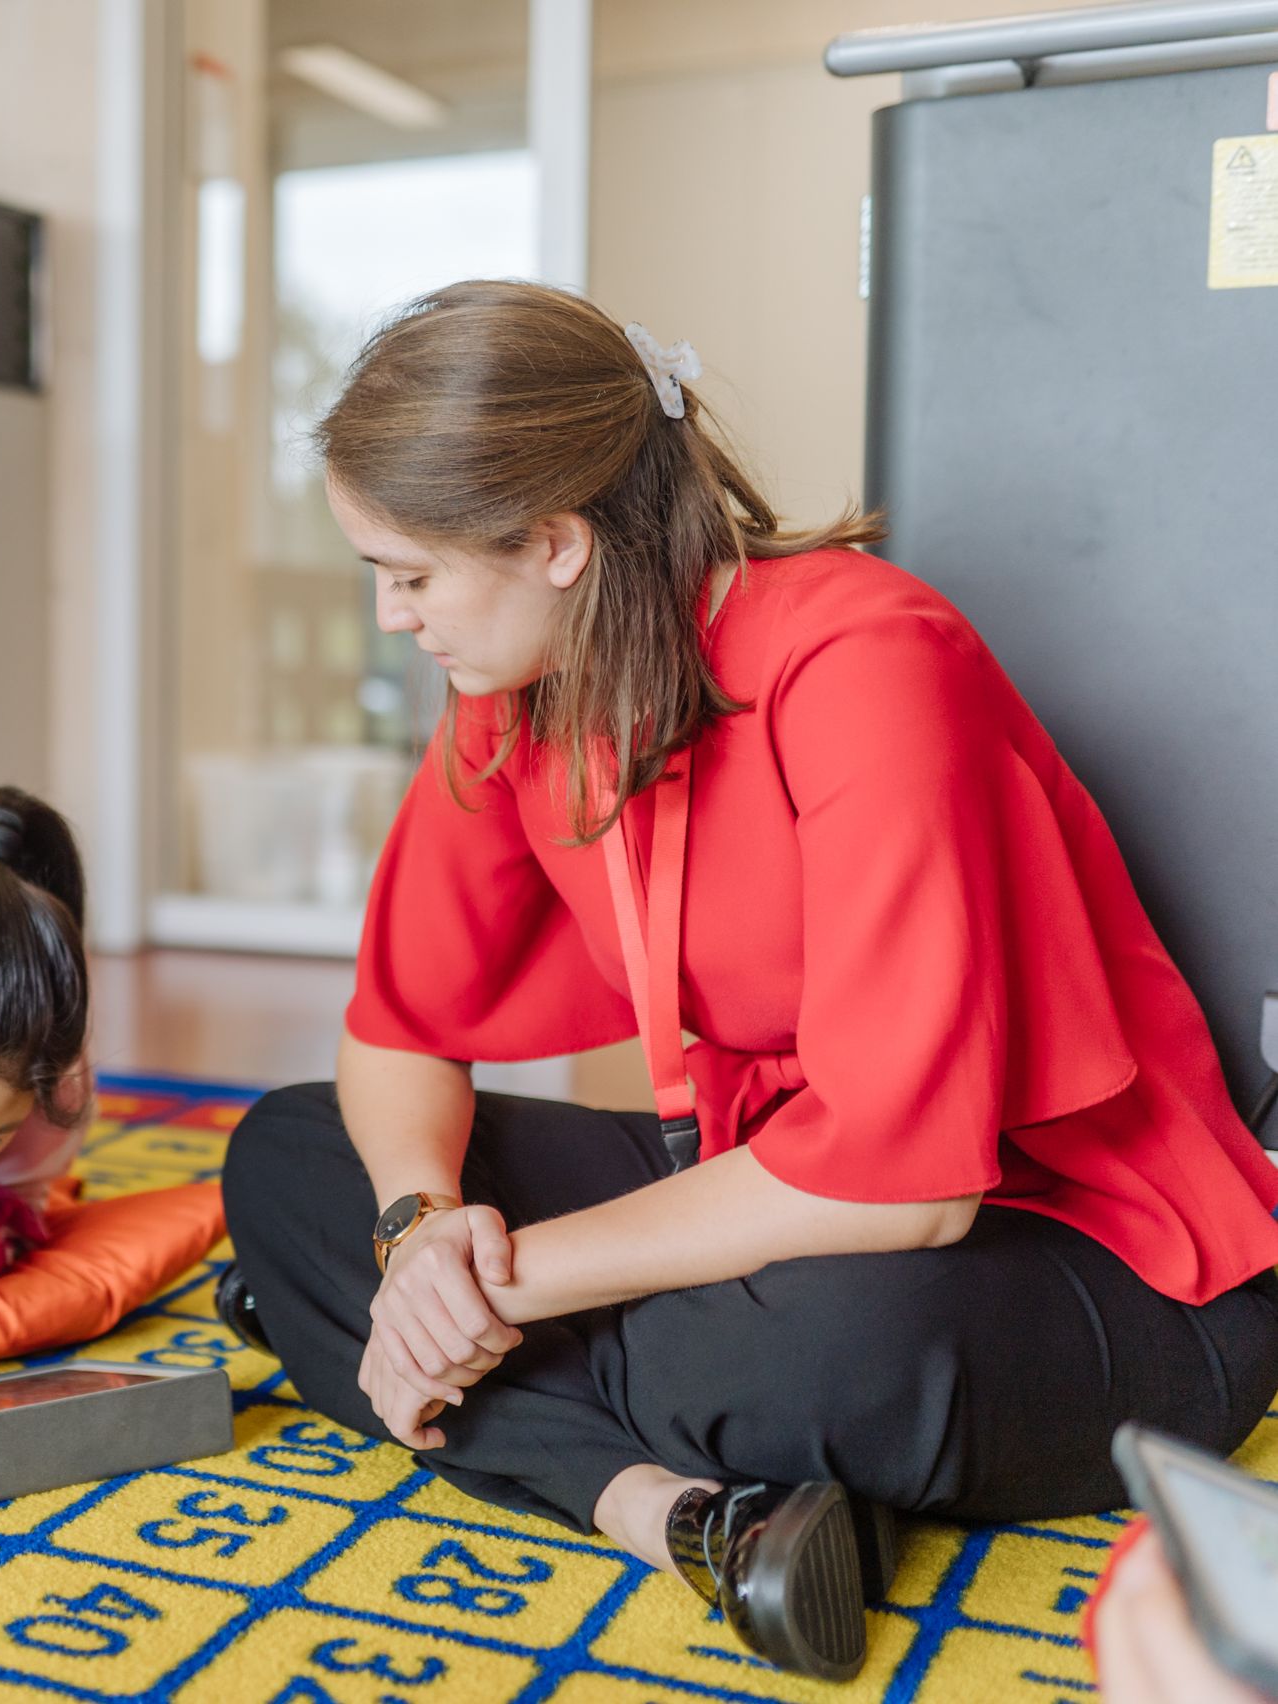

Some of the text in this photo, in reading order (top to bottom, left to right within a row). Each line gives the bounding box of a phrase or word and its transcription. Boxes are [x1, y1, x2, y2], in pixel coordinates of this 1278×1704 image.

[137, 1330, 248, 1370] 30
[248, 1423, 381, 1477] 30
[137, 1490, 289, 1558] 35
[393, 1539, 555, 1618] 28
[4, 1583, 163, 1658] 40
